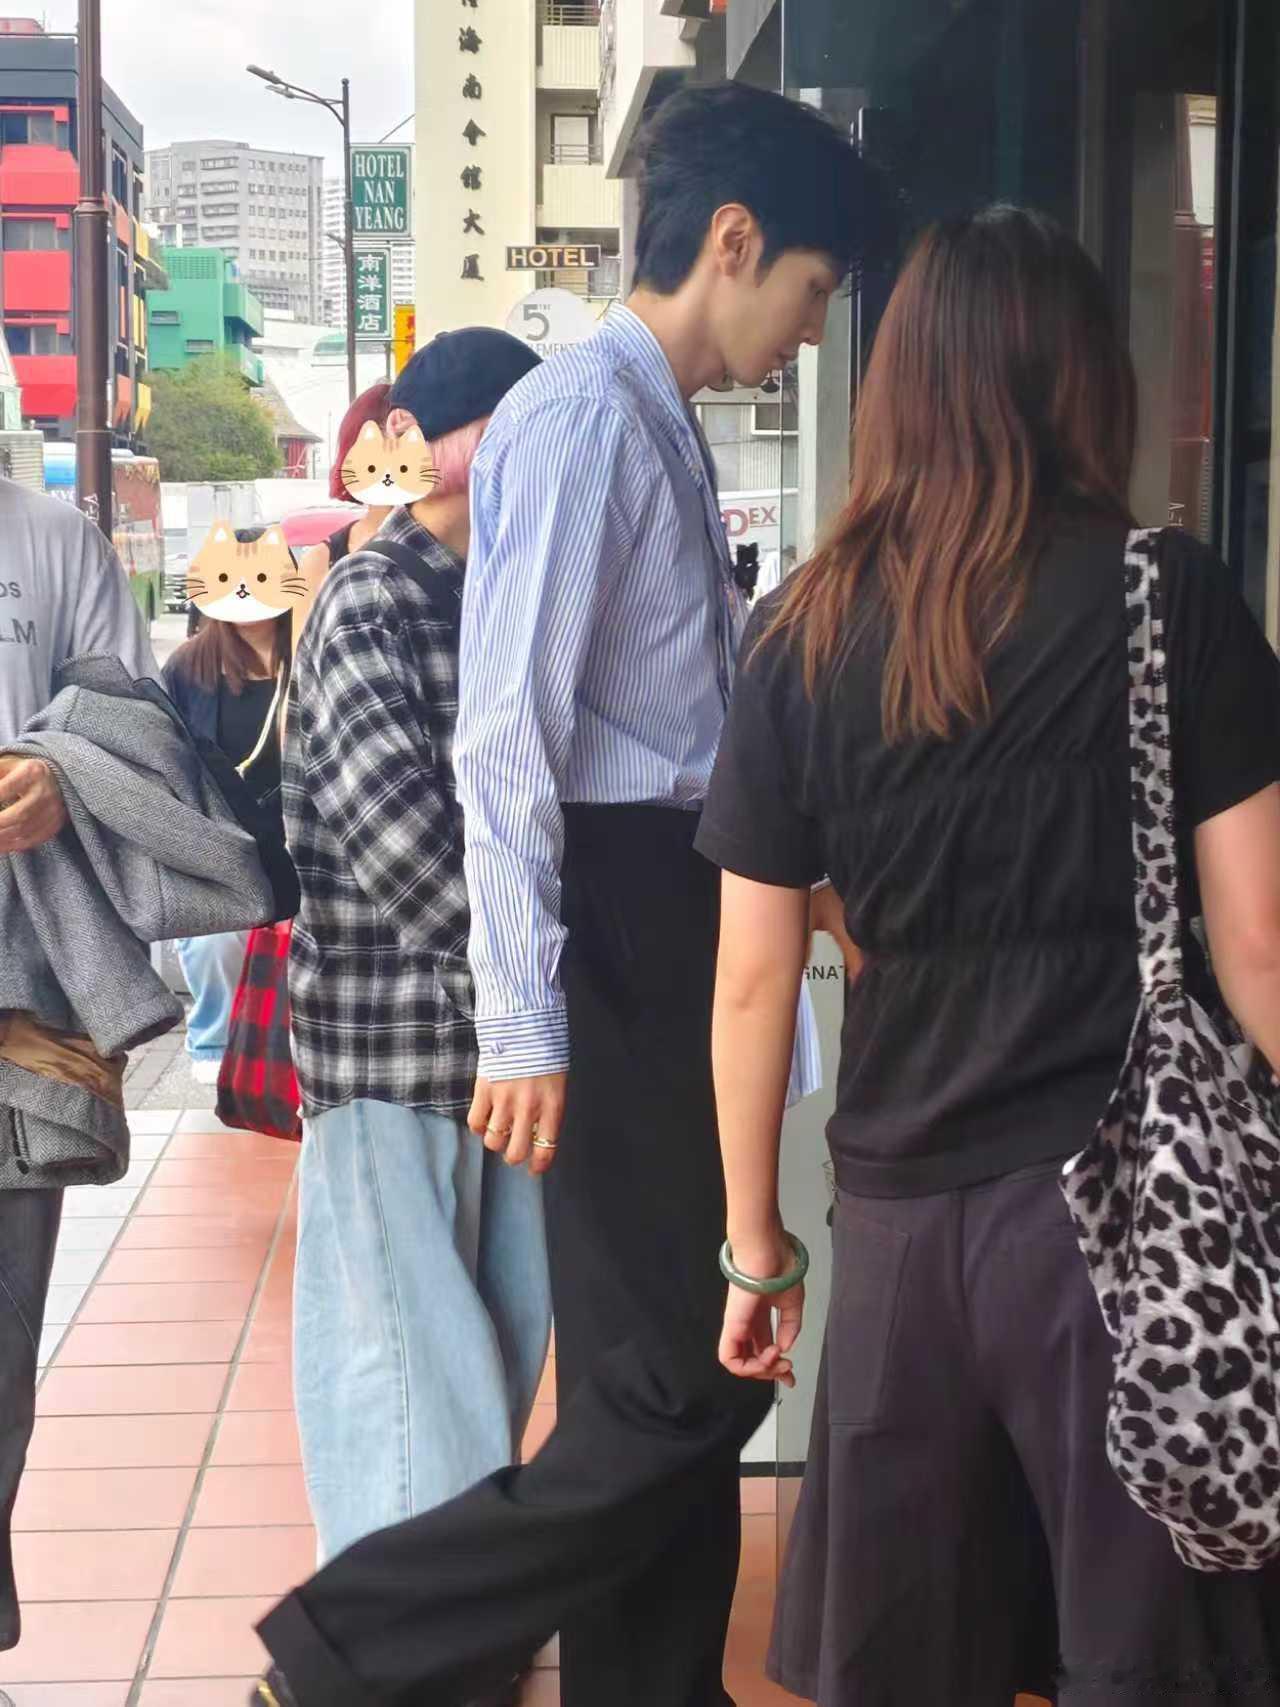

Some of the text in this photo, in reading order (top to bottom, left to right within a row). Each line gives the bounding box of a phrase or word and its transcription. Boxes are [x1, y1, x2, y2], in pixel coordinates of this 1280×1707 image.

[354, 154, 405, 178] HOTEL
[364, 180, 395, 204] NAN
[354, 206, 405, 230] YEANG
[511, 247, 596, 267] HOTEL
[357, 254, 384, 332] 南洋酒店
[522, 303, 550, 342] 5
